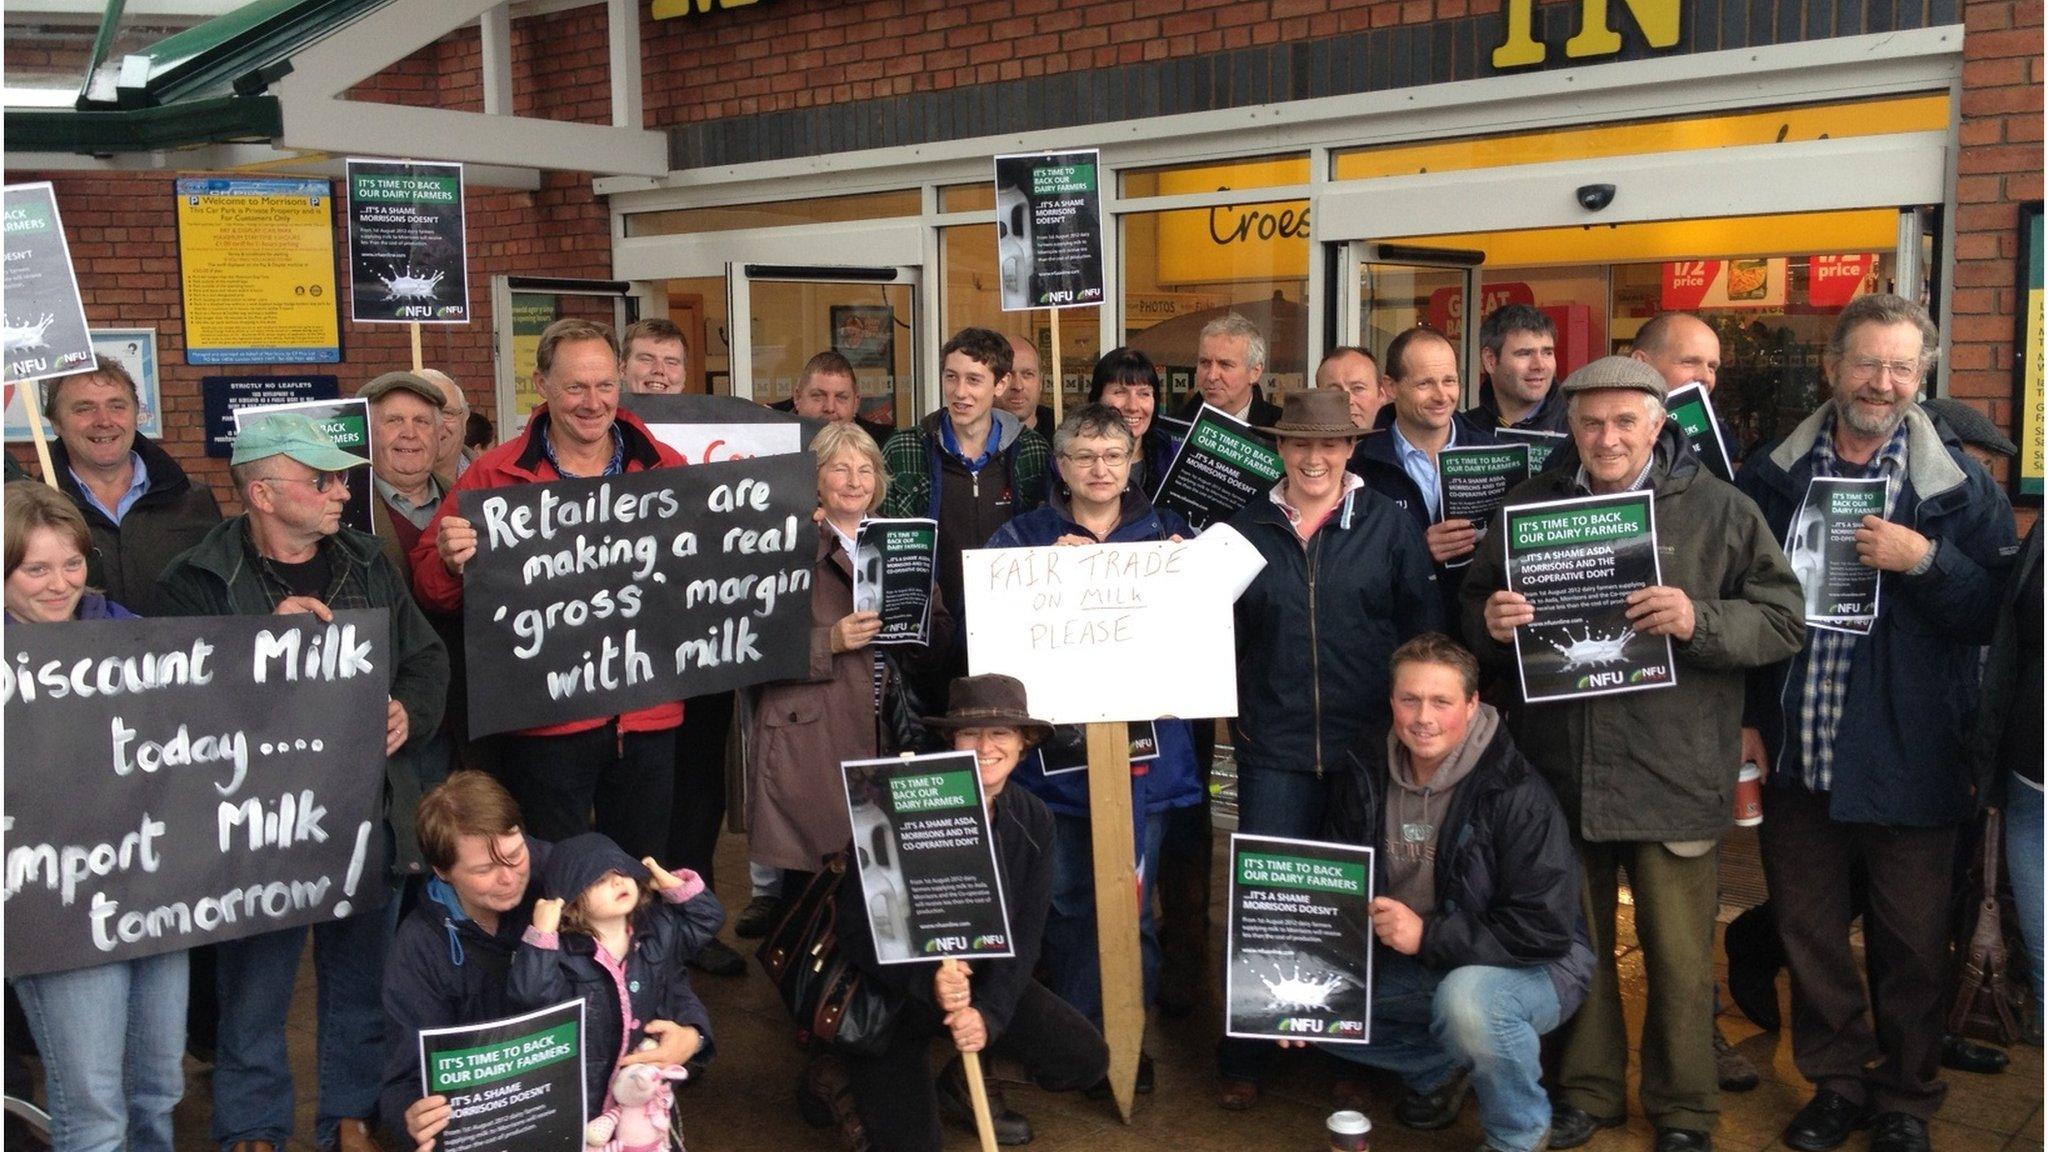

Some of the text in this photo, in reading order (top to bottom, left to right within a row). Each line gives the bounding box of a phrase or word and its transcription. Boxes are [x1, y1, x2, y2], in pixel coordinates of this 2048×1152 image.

[1493, 0, 1680, 68] IN
[378, 180, 400, 188] TIME
[403, 181, 415, 189] TO
[417, 181, 440, 189] BACK
[1035, 185, 1055, 193] DAIRY
[203, 197, 246, 205] Welcome
[262, 198, 307, 206] Morrisons
[359, 189, 452, 199] OUR DAIRY FARMERS
[1818, 263, 1861, 281] price
[1673, 276, 1704, 288] price
[1049, 288, 1100, 302] NFU NFU
[405, 306, 432, 316] NFU
[13, 351, 88, 375] NFU NFU
[1202, 426, 1274, 465] IT'S TIME TO BACK
[1198, 436, 1280, 480] OUR DAIRY FARMERS
[1445, 457, 1459, 465] IT'S
[1465, 464, 1486, 472] DAIRY
[1487, 461, 1521, 470] FARMERS
[1186, 458, 1257, 495] MORRISONS DOESN'T
[1206, 458, 1213, 466] A
[1215, 462, 1241, 478] SHAME
[482, 477, 771, 550] Retailers are
[1519, 512, 1621, 532] IT'S TIME TO BACK
[1519, 522, 1638, 544] OUR DAIRY FARMERS
[523, 513, 798, 585] making a real
[1543, 552, 1551, 560] A
[1553, 548, 1585, 559] SHAME
[990, 546, 1188, 590] FAIR TRADE
[1521, 557, 1615, 574] MORRISONS AND THE
[1522, 568, 1615, 585] CO-OPERATIVE DON'T
[686, 568, 811, 618] margin
[1033, 592, 1061, 611] ON
[1838, 603, 1860, 613] NFU
[890, 623, 907, 632] NFU
[1031, 614, 1134, 650] PLEASE
[253, 623, 374, 684] Milk
[547, 615, 764, 701] with milk
[1588, 666, 1666, 687] NFU NFU
[1135, 738, 1152, 748] NFU
[890, 777, 944, 789] IT'S TIME TO
[892, 788, 938, 800] BACK OUR
[895, 796, 965, 810] DAIRY FARMERS
[218, 789, 329, 853] Milk
[926, 819, 950, 828] SHAME
[900, 827, 979, 841] MORRISONS AND THE
[903, 837, 979, 851] CO-OPERATIVE DON'T
[1244, 859, 1342, 877] IT'S TIME TO BACK
[1244, 870, 1358, 890] OUR DAIRY FARMERS
[1277, 893, 1311, 904] SHAME
[1243, 901, 1339, 916] MORRISONS DOESN'T
[935, 935, 1004, 951] NFU NFU
[1290, 1018, 1362, 1032] NFU NFU
[438, 1035, 555, 1070] IT'S TIME TO BACK
[440, 1043, 570, 1085] OUR DAIRY FARMERS
[472, 1093, 482, 1103] A
[484, 1081, 522, 1100] SHAME
[509, 1083, 552, 1104] DOESN'T
